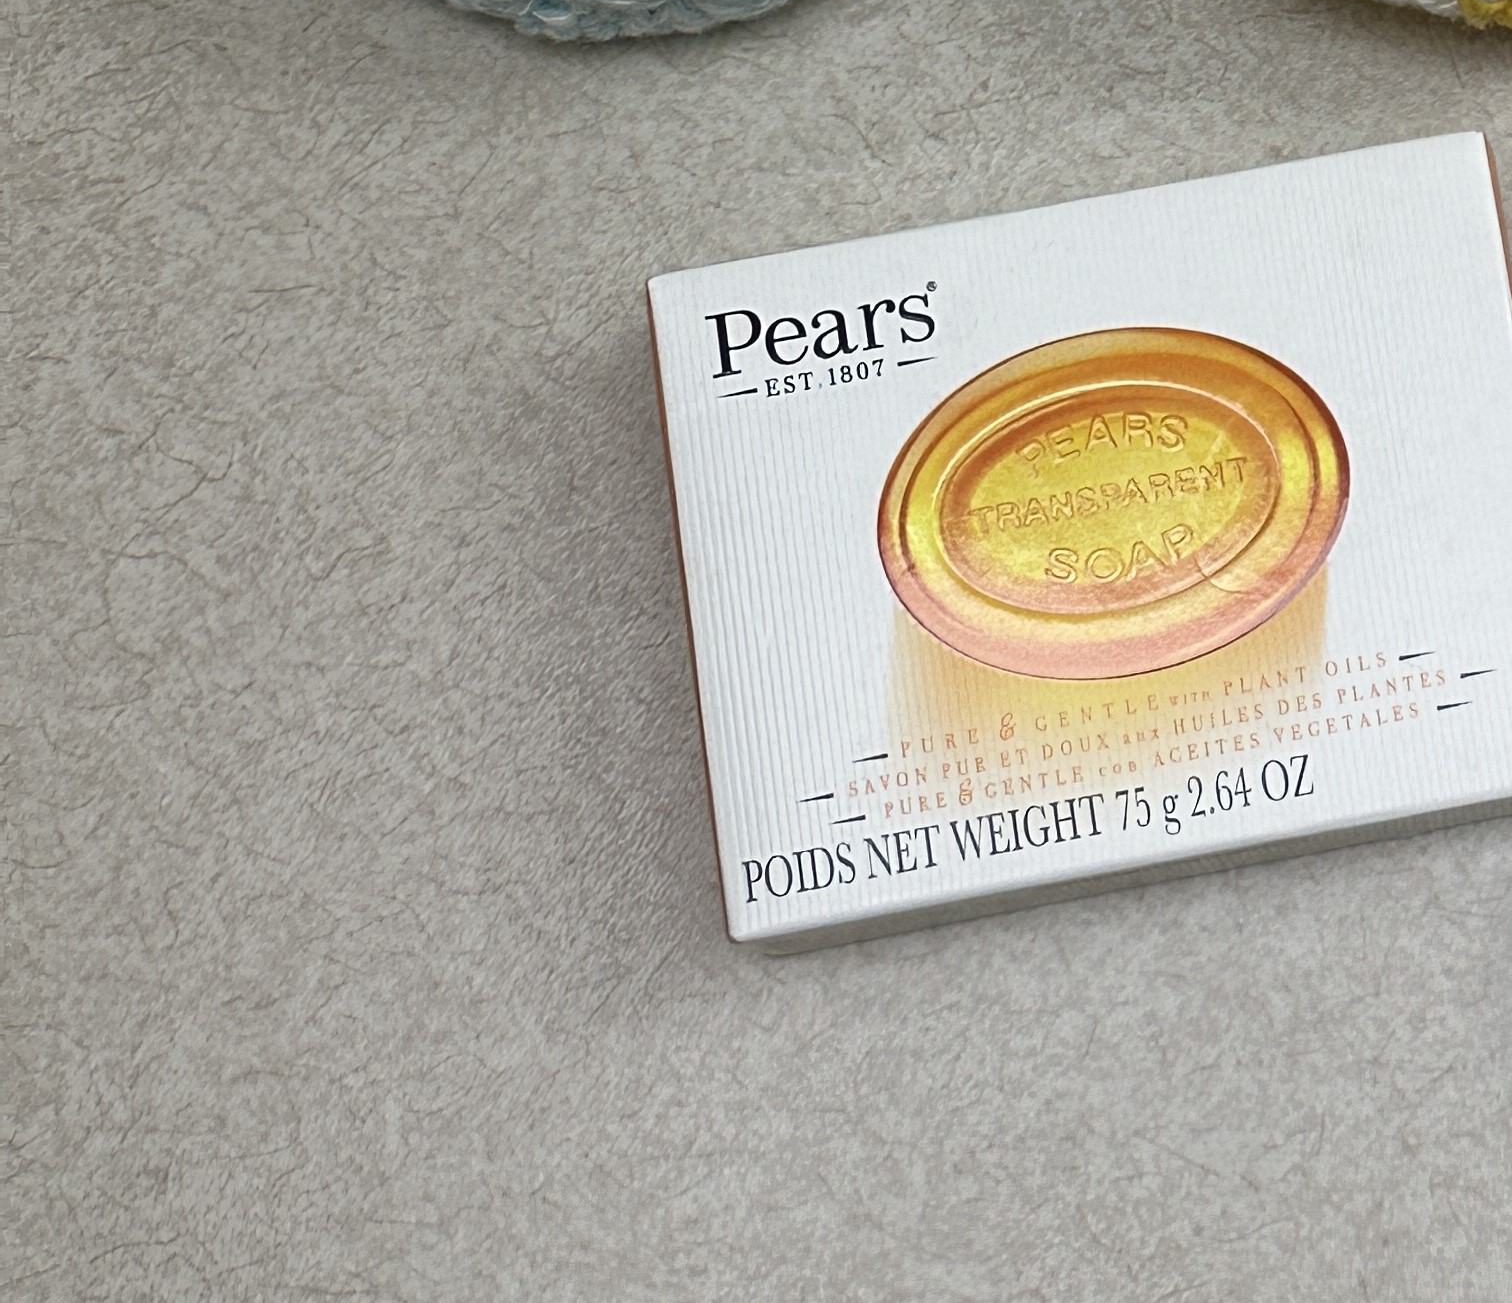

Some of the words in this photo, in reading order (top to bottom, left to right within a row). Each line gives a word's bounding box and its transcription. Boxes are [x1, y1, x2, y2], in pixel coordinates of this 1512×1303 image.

[969, 456, 1248, 534] TRANSPARENT
[1015, 411, 1189, 479] PEARS
[1044, 523, 1194, 584] SOAP
[849, 767, 928, 797] SAVON
[942, 756, 986, 780] PUR
[1000, 747, 1029, 769] ET
[1041, 732, 1110, 761] DOUX
[1173, 702, 1263, 736] HUILES
[1277, 692, 1322, 716] DES
[1336, 669, 1446, 705] PLANTES
[900, 728, 979, 758] PURE
[999, 712, 1016, 741] &
[1035, 694, 1159, 732] GENTLE
[1223, 666, 1307, 696] PLANT
[1325, 651, 1387, 677] OILS
[884, 791, 947, 819] PURE
[984, 765, 1084, 799] GENTLE
[1154, 732, 1260, 767] ACEITES
[1274, 702, 1419, 744] VEGETALES
[741, 841, 857, 904] POIDS
[863, 824, 940, 881] NET
[950, 793, 1105, 862] WEIGHT
[1115, 785, 1152, 831] 75
[1163, 793, 1180, 836] g
[1187, 767, 1252, 818] 2.64
[1261, 754, 1315, 802] OZ
